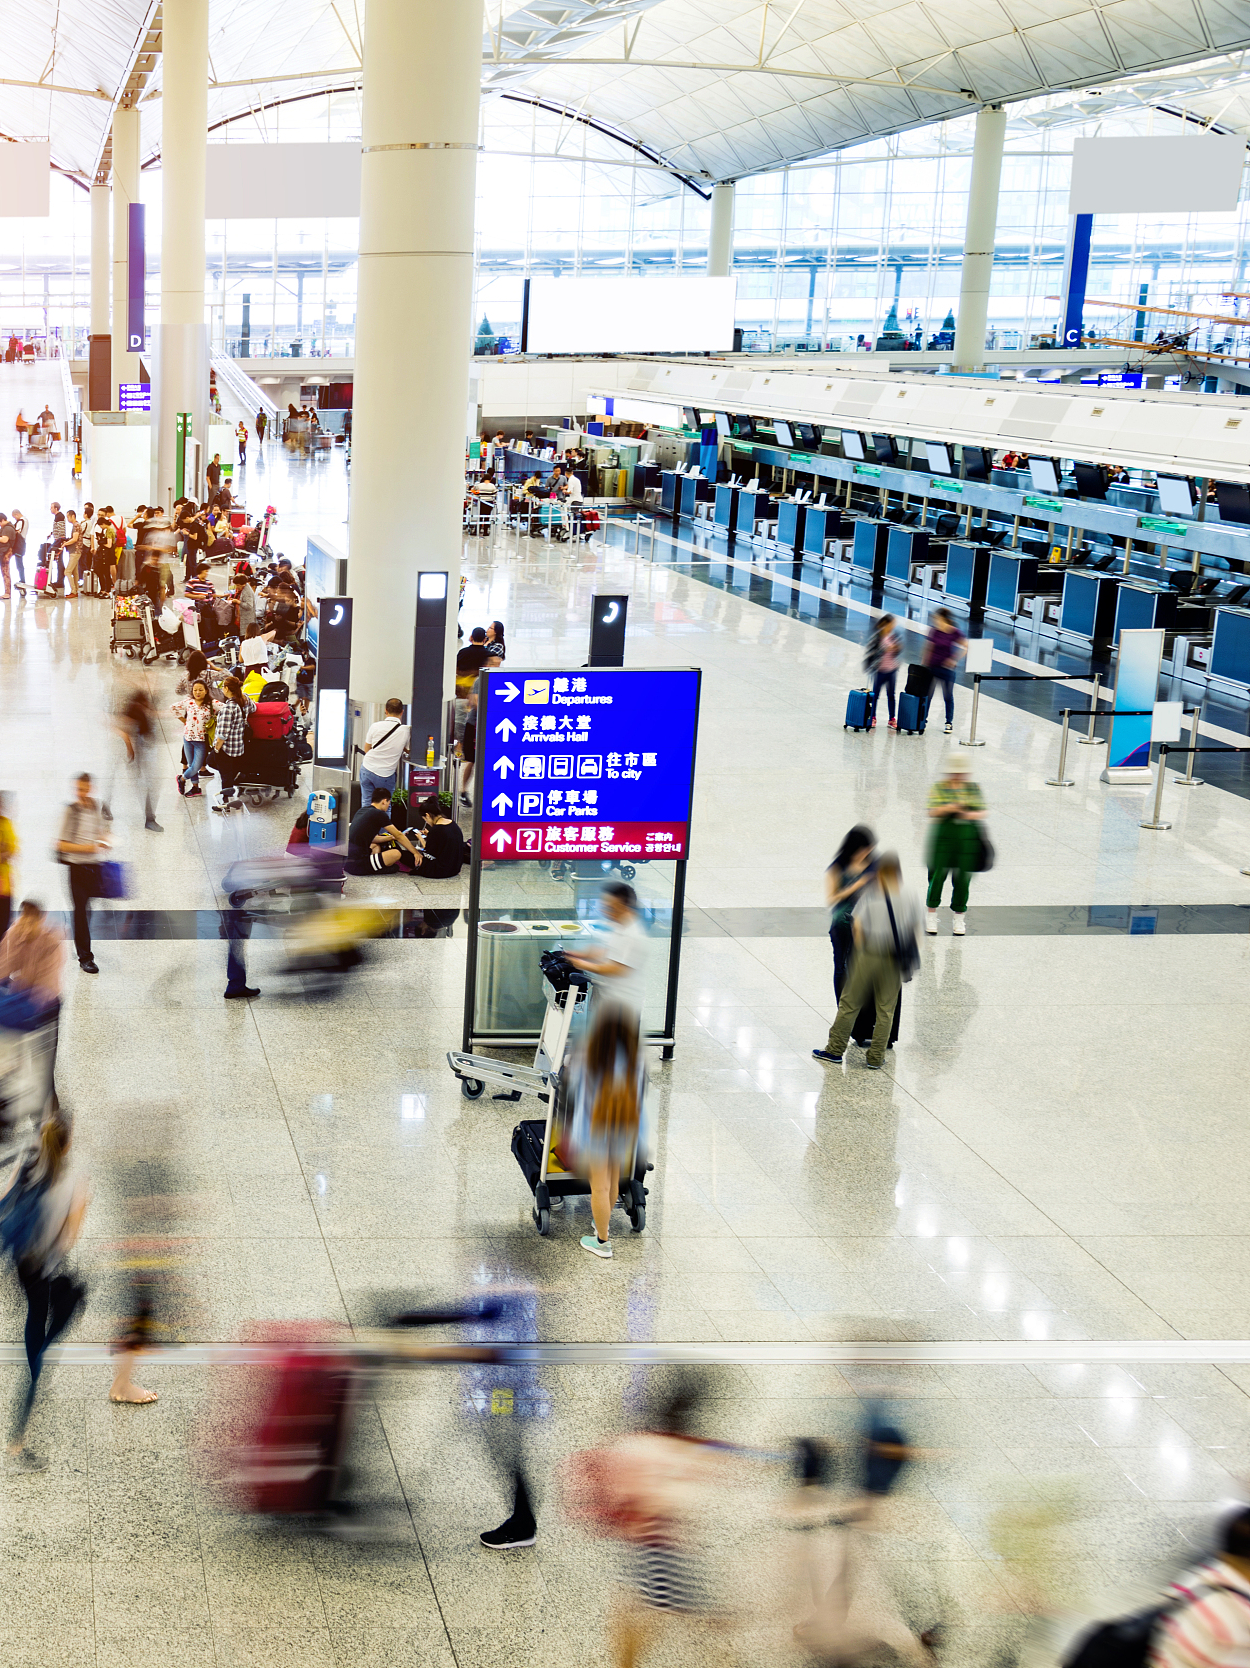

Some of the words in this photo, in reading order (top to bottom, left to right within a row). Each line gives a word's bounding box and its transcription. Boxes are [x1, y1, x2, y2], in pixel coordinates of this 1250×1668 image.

[130, 334, 142, 348] D
[1066, 329, 1079, 342] C
[551, 693, 614, 707] Departures
[521, 714, 592, 731] 接機大堂
[521, 731, 566, 742] Arrivals
[566, 731, 589, 742] Hall
[605, 751, 658, 768] 往市區
[604, 768, 620, 779] To
[620, 767, 643, 781] city
[546, 789, 599, 805] 停車場
[545, 805, 567, 817] Car
[567, 805, 599, 817] Parks
[544, 825, 615, 842] 旅客服務
[544, 841, 600, 853] Customer
[600, 841, 642, 853] Service
